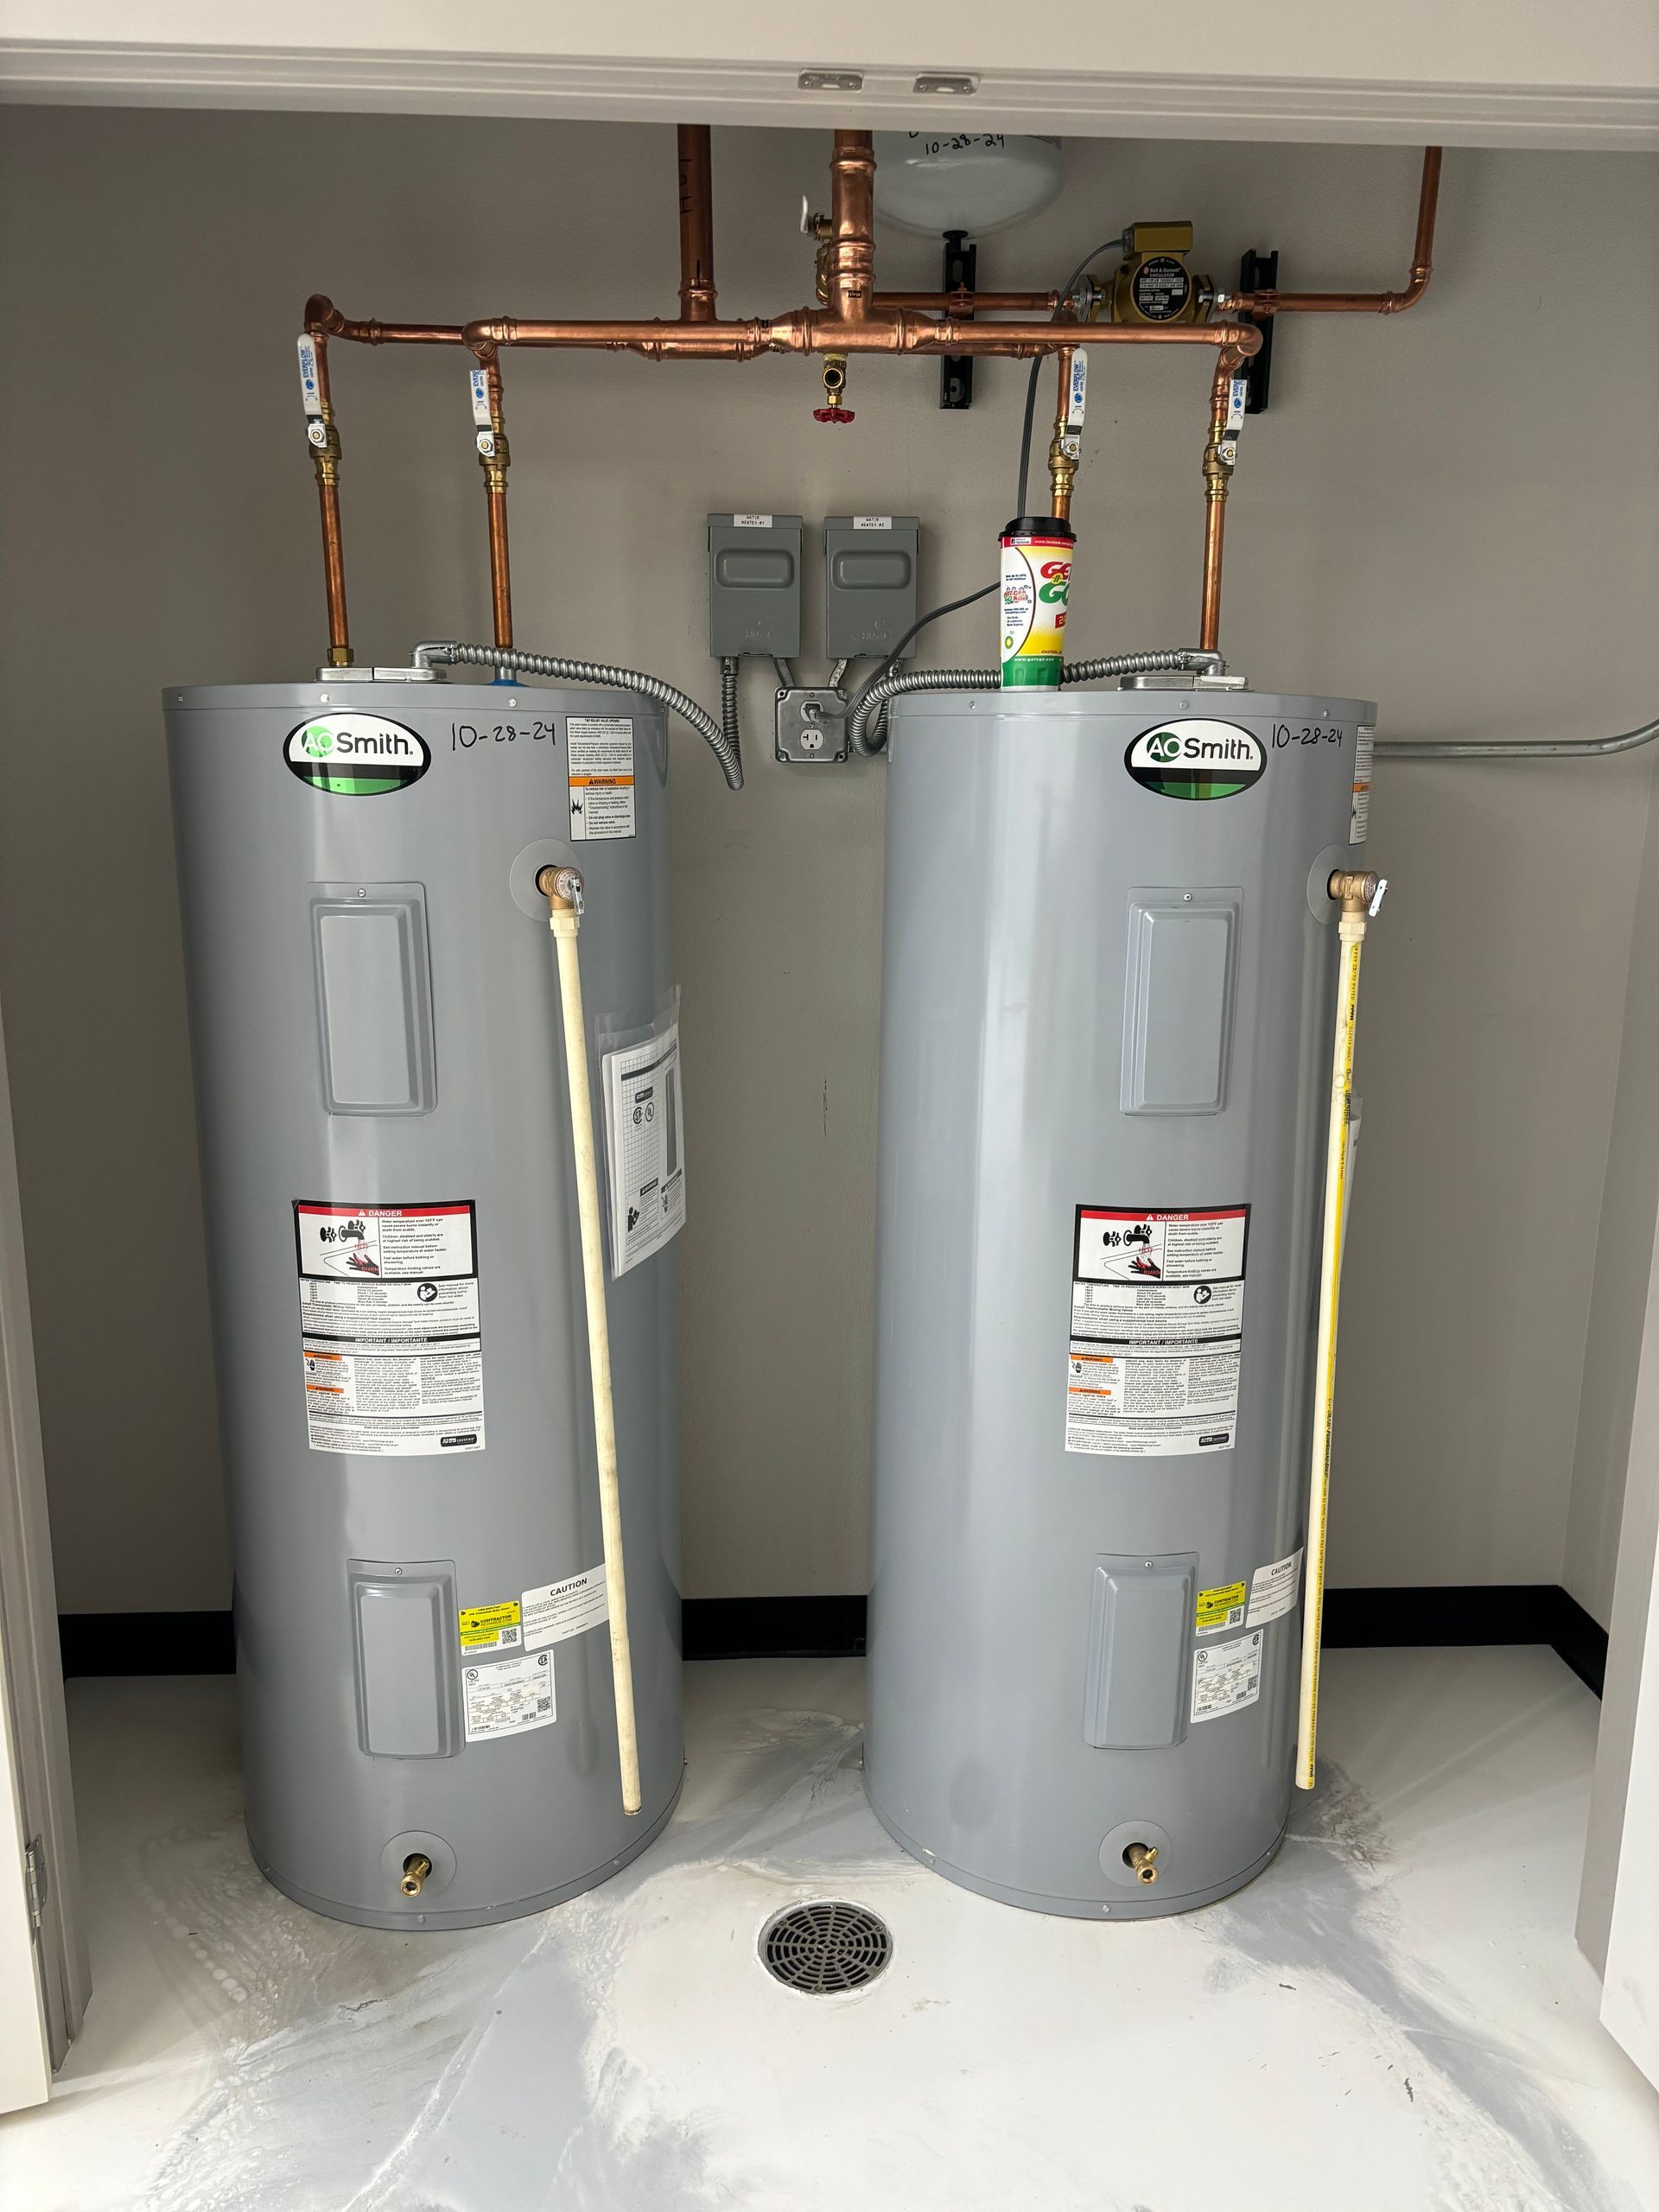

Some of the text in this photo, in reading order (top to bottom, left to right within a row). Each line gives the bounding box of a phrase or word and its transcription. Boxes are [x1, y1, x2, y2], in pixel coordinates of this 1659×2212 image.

[925, 133, 1006, 156] 10-28-24
[1040, 561, 1071, 582] GE
[337, 732, 410, 755] Smith
[452, 721, 556, 751] 10-28-24
[1147, 734, 1250, 760] AO Smith
[1272, 723, 1343, 748] 10-28-24
[1271, 1561, 1292, 1575] CAUTION
[550, 1578, 588, 1596] CAUTION
[480, 1614, 512, 1624] CONTRACTOR
